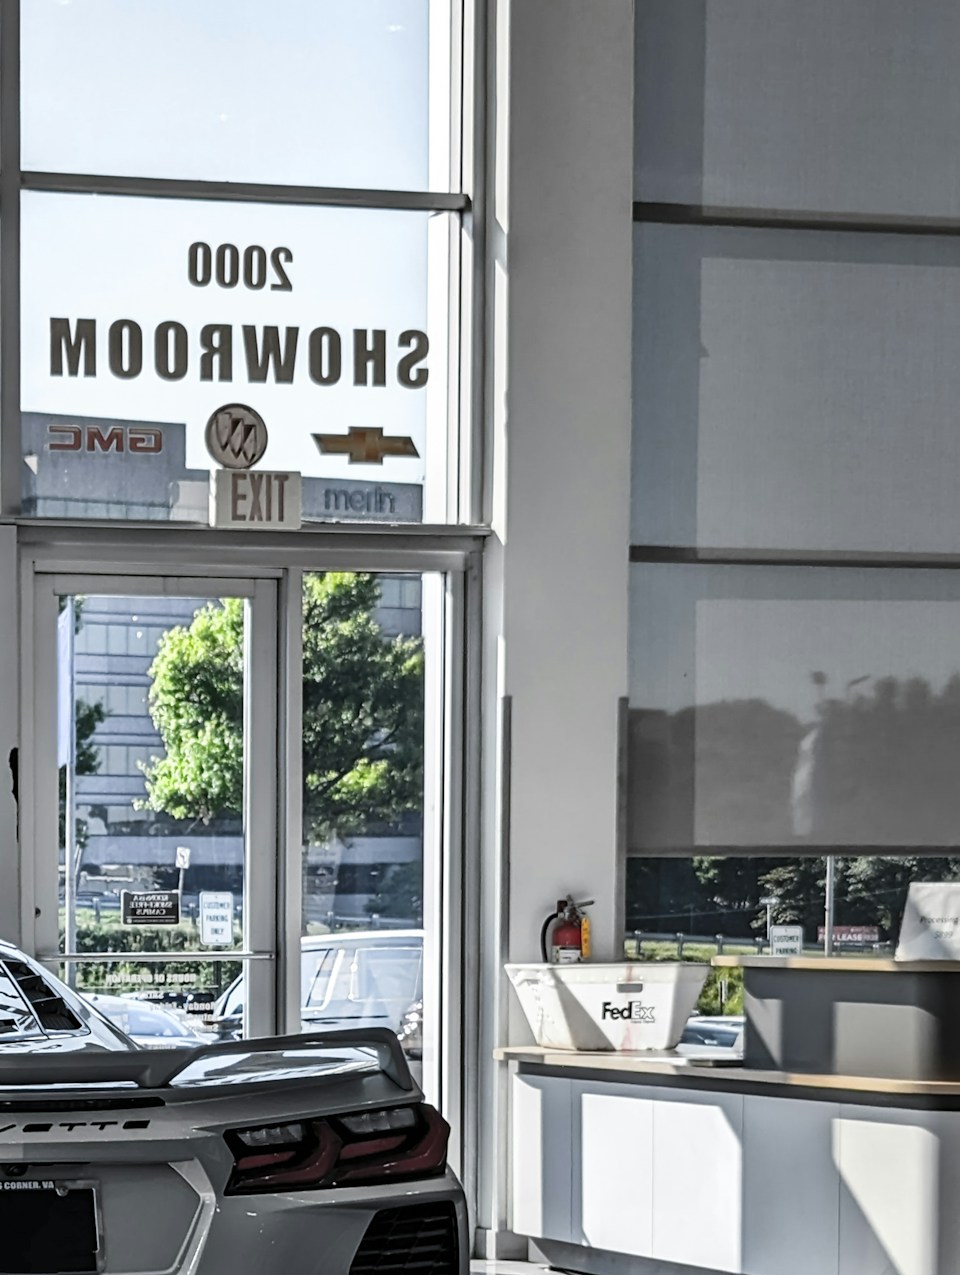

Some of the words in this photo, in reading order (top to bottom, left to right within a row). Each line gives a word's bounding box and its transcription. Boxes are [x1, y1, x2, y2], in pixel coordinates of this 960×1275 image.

[230, 473, 290, 522] EXIT
[203, 901, 231, 909] CUSTOMER
[206, 914, 229, 922] PARKING
[836, 933, 863, 941] LEASE
[602, 1000, 655, 1020] FedEx
[42, 1181, 55, 1189] VA
